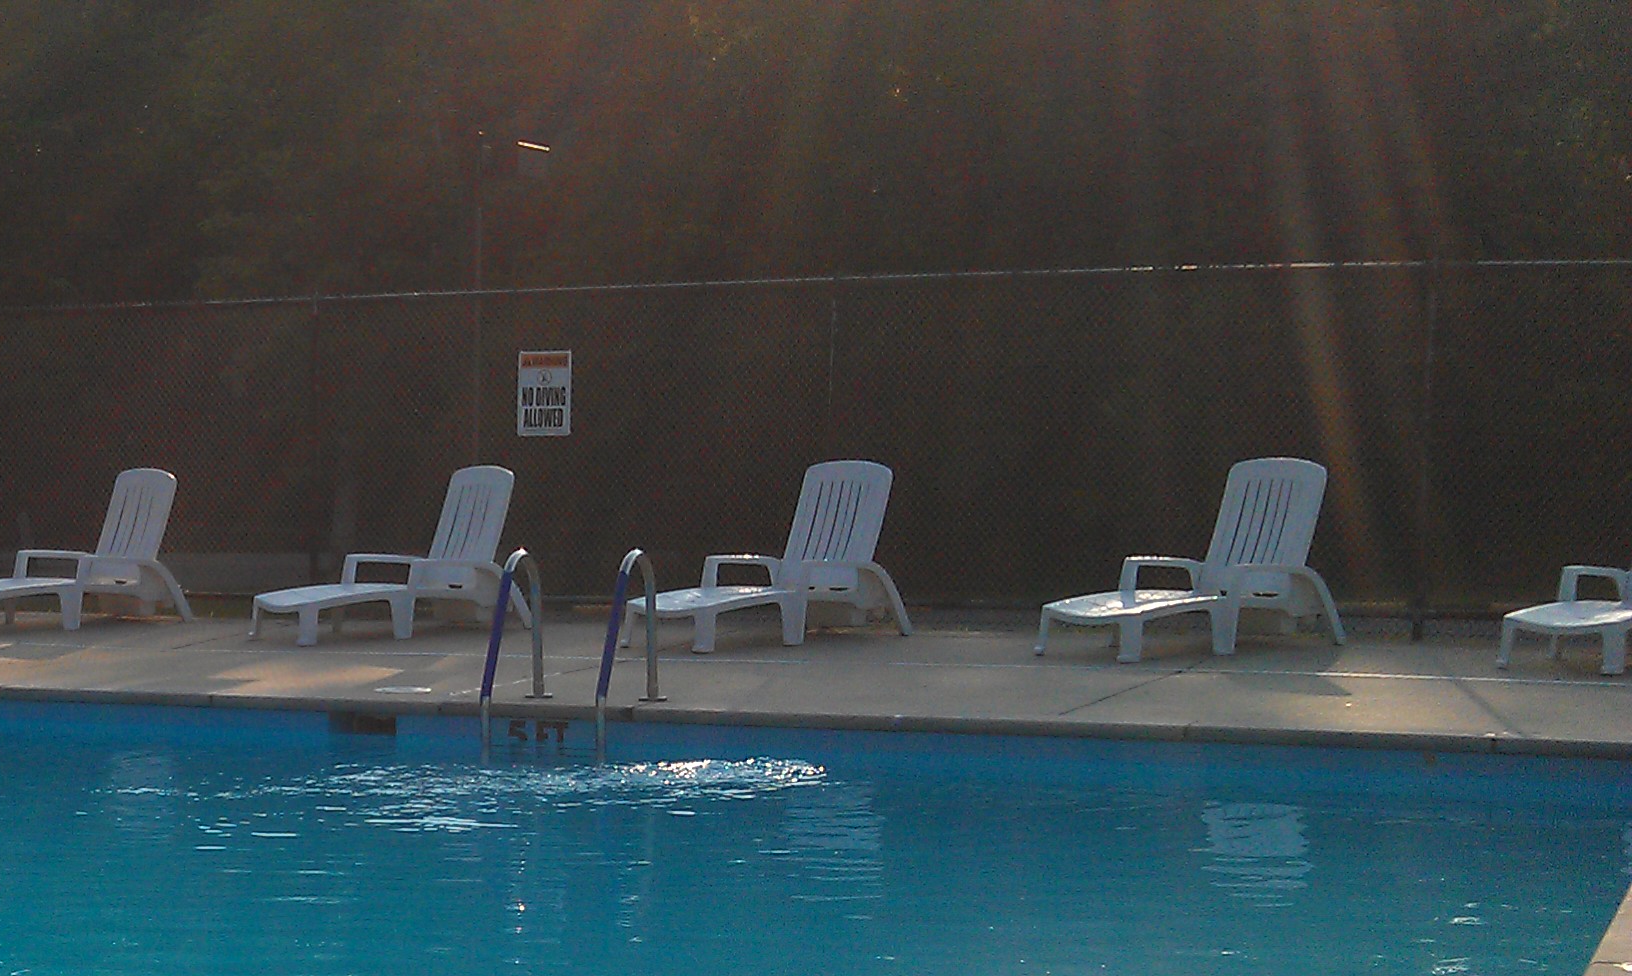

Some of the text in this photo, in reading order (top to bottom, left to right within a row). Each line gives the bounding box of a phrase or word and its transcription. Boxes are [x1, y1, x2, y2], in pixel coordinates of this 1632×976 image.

[521, 386, 566, 407] NO DIVING
[523, 408, 563, 428] ALLOWED
[535, 720, 569, 743] FT
